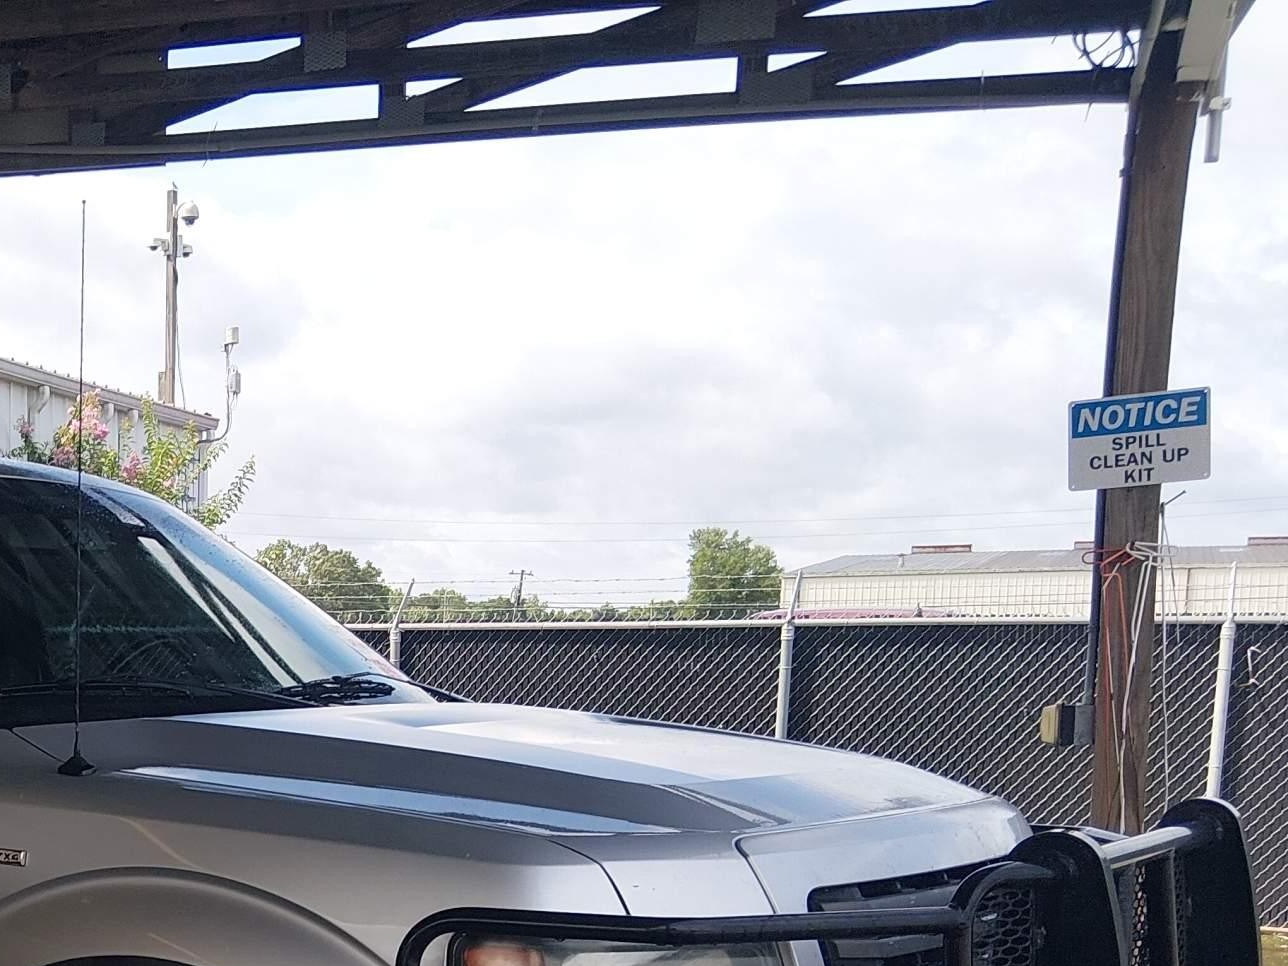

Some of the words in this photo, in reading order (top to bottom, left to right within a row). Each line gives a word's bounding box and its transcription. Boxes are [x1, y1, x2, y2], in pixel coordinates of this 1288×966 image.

[1077, 395, 1201, 433] NOTICE
[1111, 433, 1166, 451] SPILL
[1089, 450, 1153, 470] CLEAN
[1162, 447, 1190, 464] UP
[1124, 467, 1155, 484] KIT
